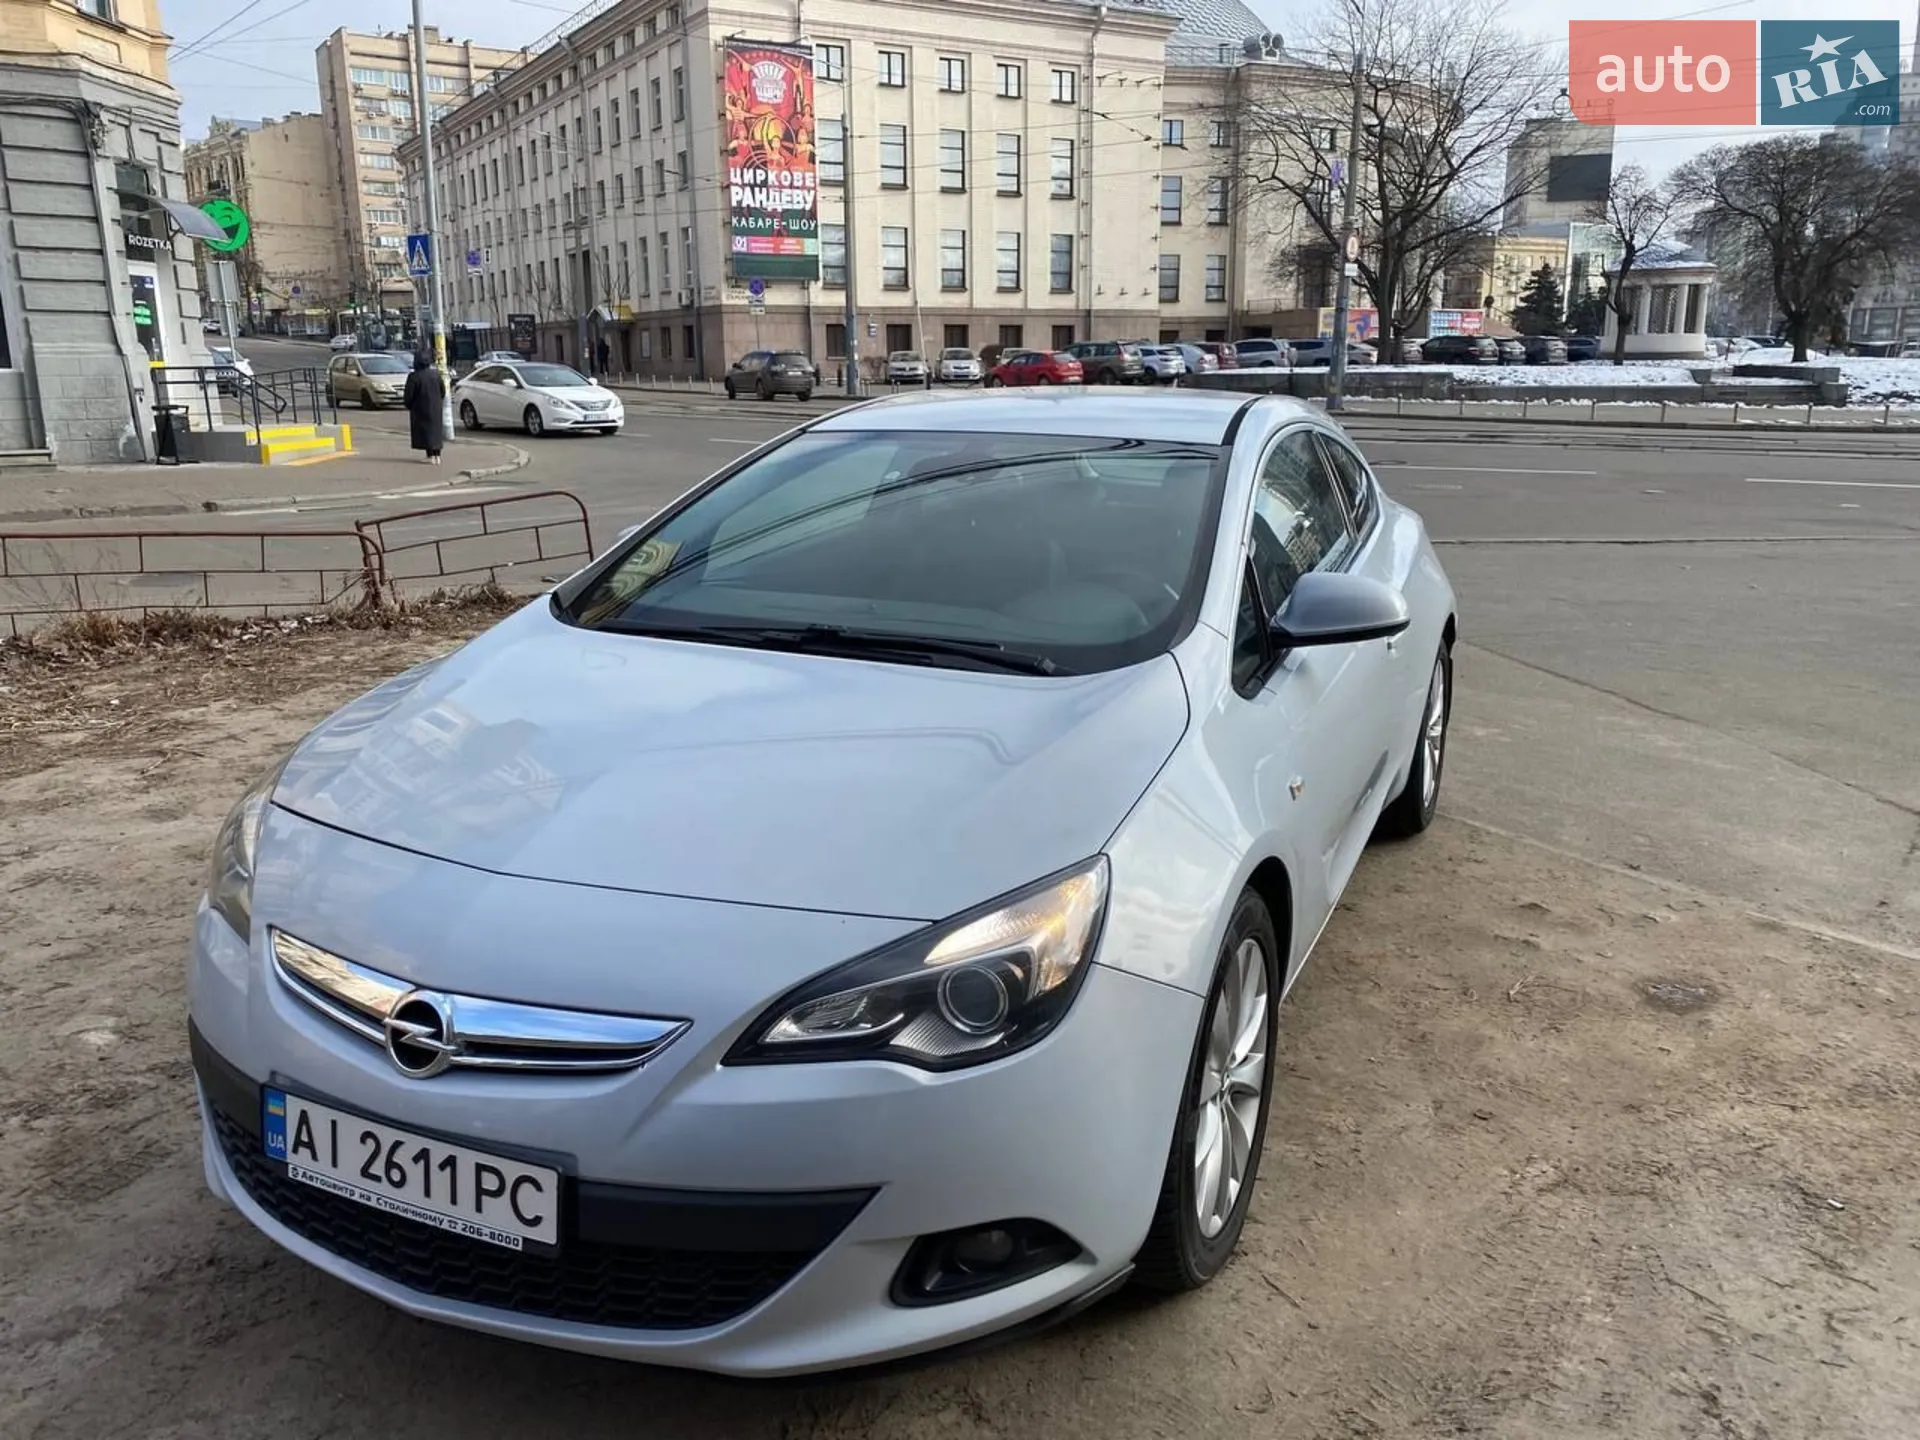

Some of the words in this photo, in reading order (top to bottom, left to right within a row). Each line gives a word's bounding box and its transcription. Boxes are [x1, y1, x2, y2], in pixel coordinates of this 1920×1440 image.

[730, 167, 815, 187] ЦИРКОВЕ
[731, 186, 816, 212] РАНДЕВУ
[128, 234, 173, 251] ROZETKA
[267, 1131, 286, 1151] UA
[359, 1130, 458, 1207] 2611
[301, 1170, 356, 1198] Автоцентр
[359, 1193, 371, 1202] на
[376, 1197, 445, 1227] Столичному
